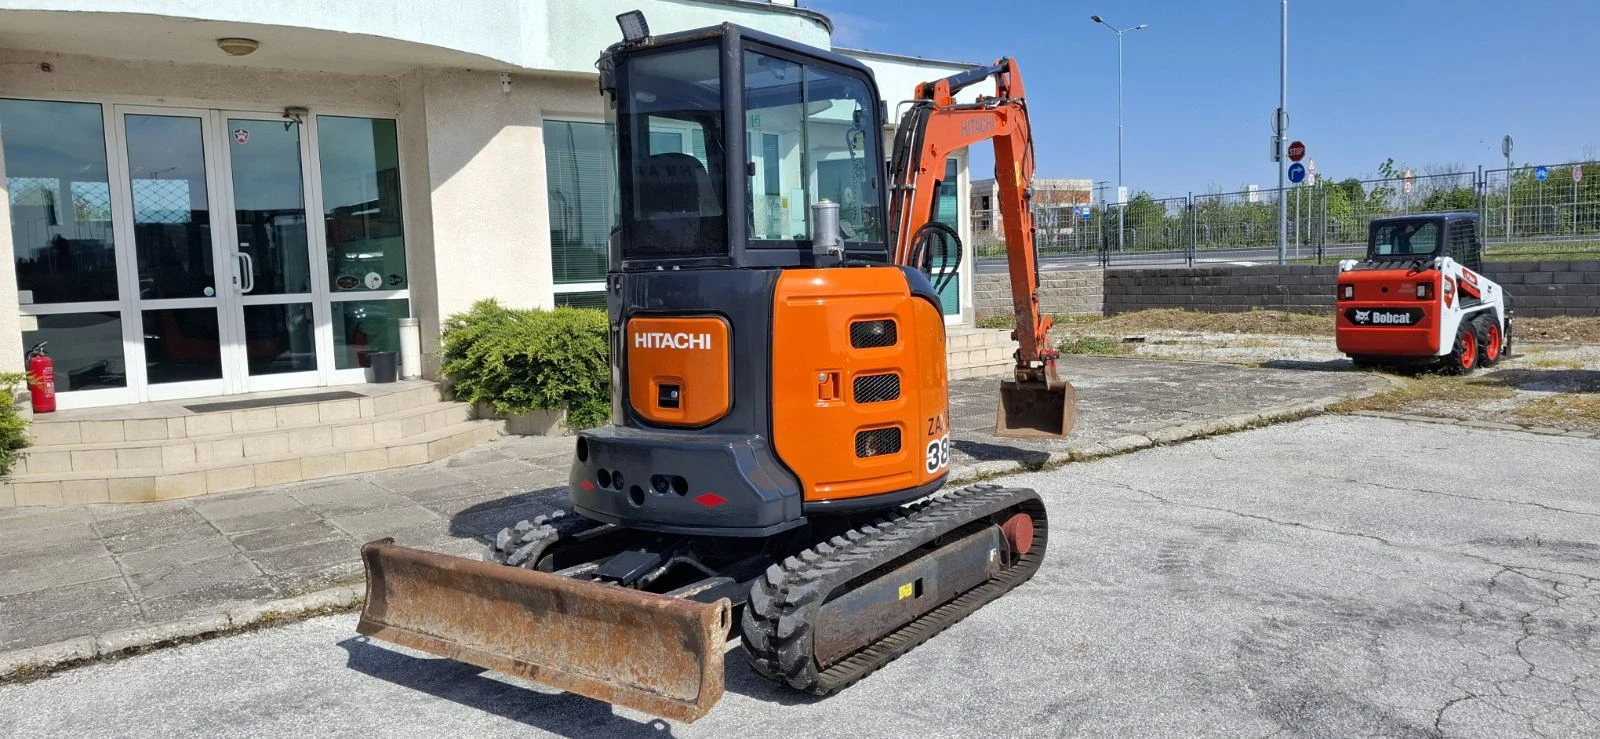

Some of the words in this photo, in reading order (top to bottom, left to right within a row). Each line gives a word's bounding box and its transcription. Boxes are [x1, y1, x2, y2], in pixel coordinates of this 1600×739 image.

[961, 114, 995, 137] HITACHI
[1289, 147, 1304, 156] STOP
[1372, 311, 1410, 324] Bobcat
[634, 332, 711, 350] HITACHI
